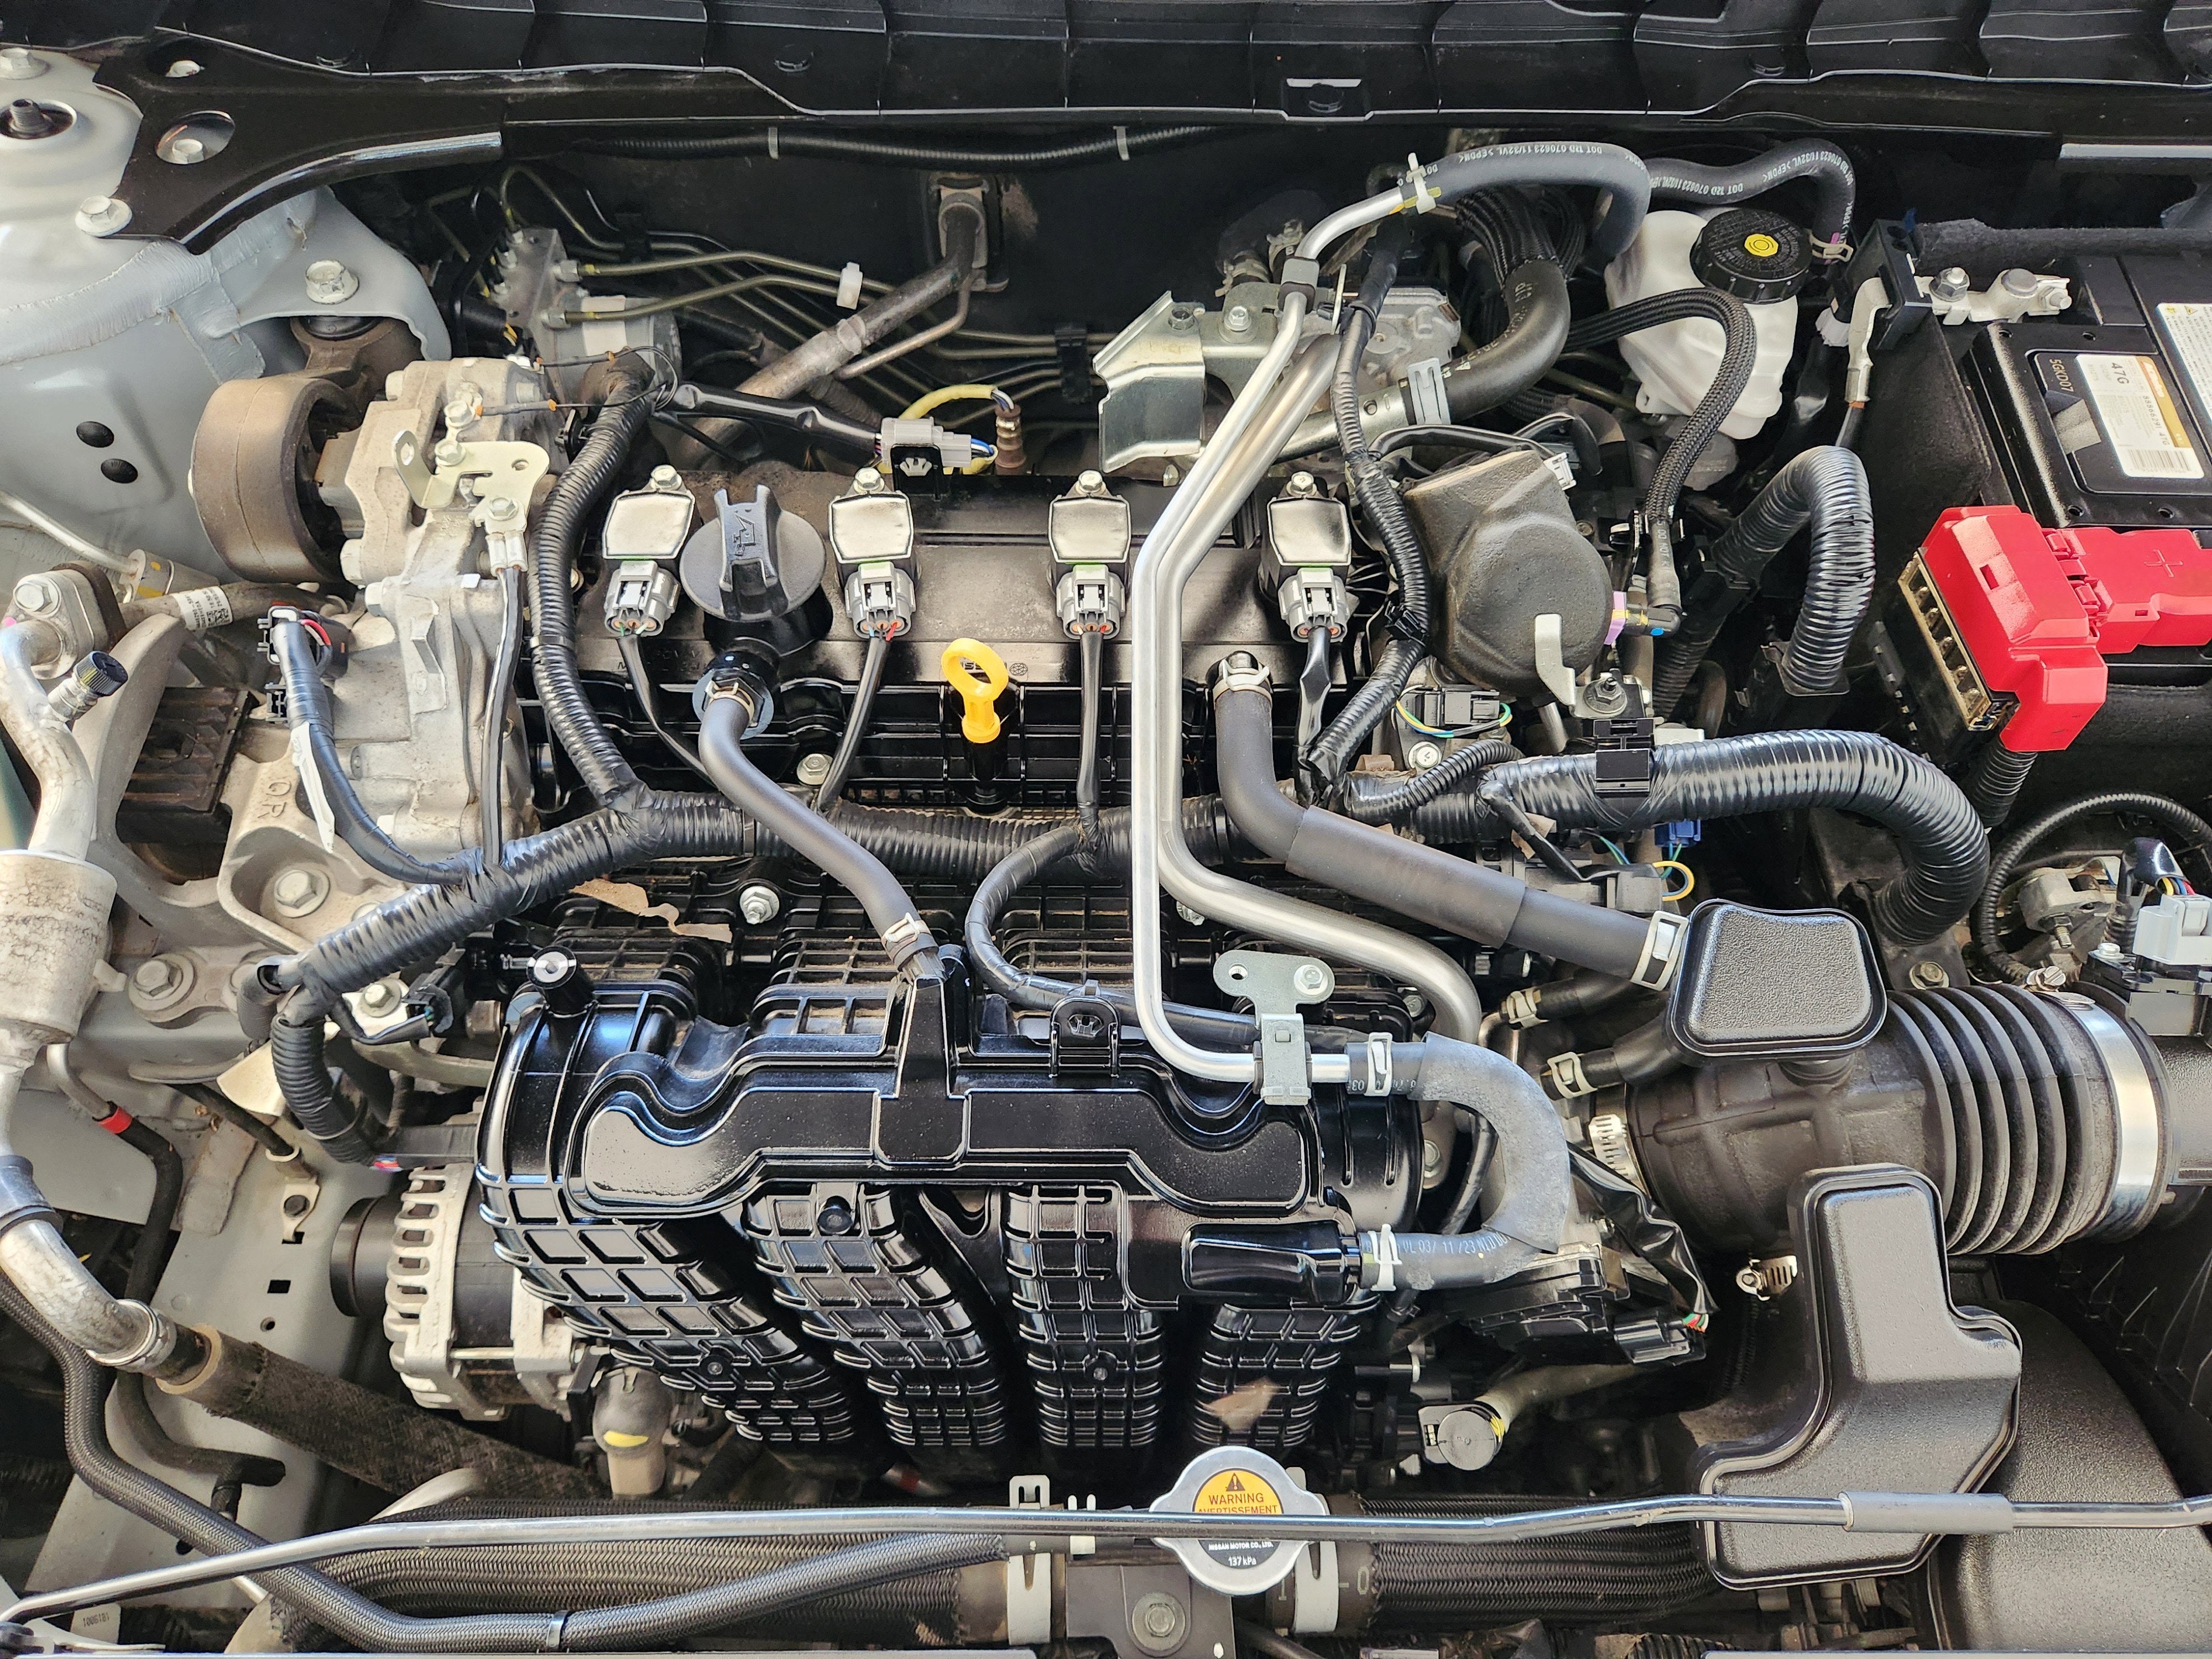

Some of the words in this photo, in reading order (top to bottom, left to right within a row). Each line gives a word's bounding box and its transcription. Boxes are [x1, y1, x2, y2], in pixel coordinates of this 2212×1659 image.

[1535, 144, 1567, 154] 070623
[1587, 146, 1601, 154] DOT
[1728, 183, 1743, 195] DOT
[2049, 359, 2074, 392] 5GKD07
[2111, 362, 2130, 384] 47G
[1209, 1493, 1264, 1505] WARNING
[1228, 1556, 1241, 1566] 137
[1243, 1556, 1256, 1566] kPa
